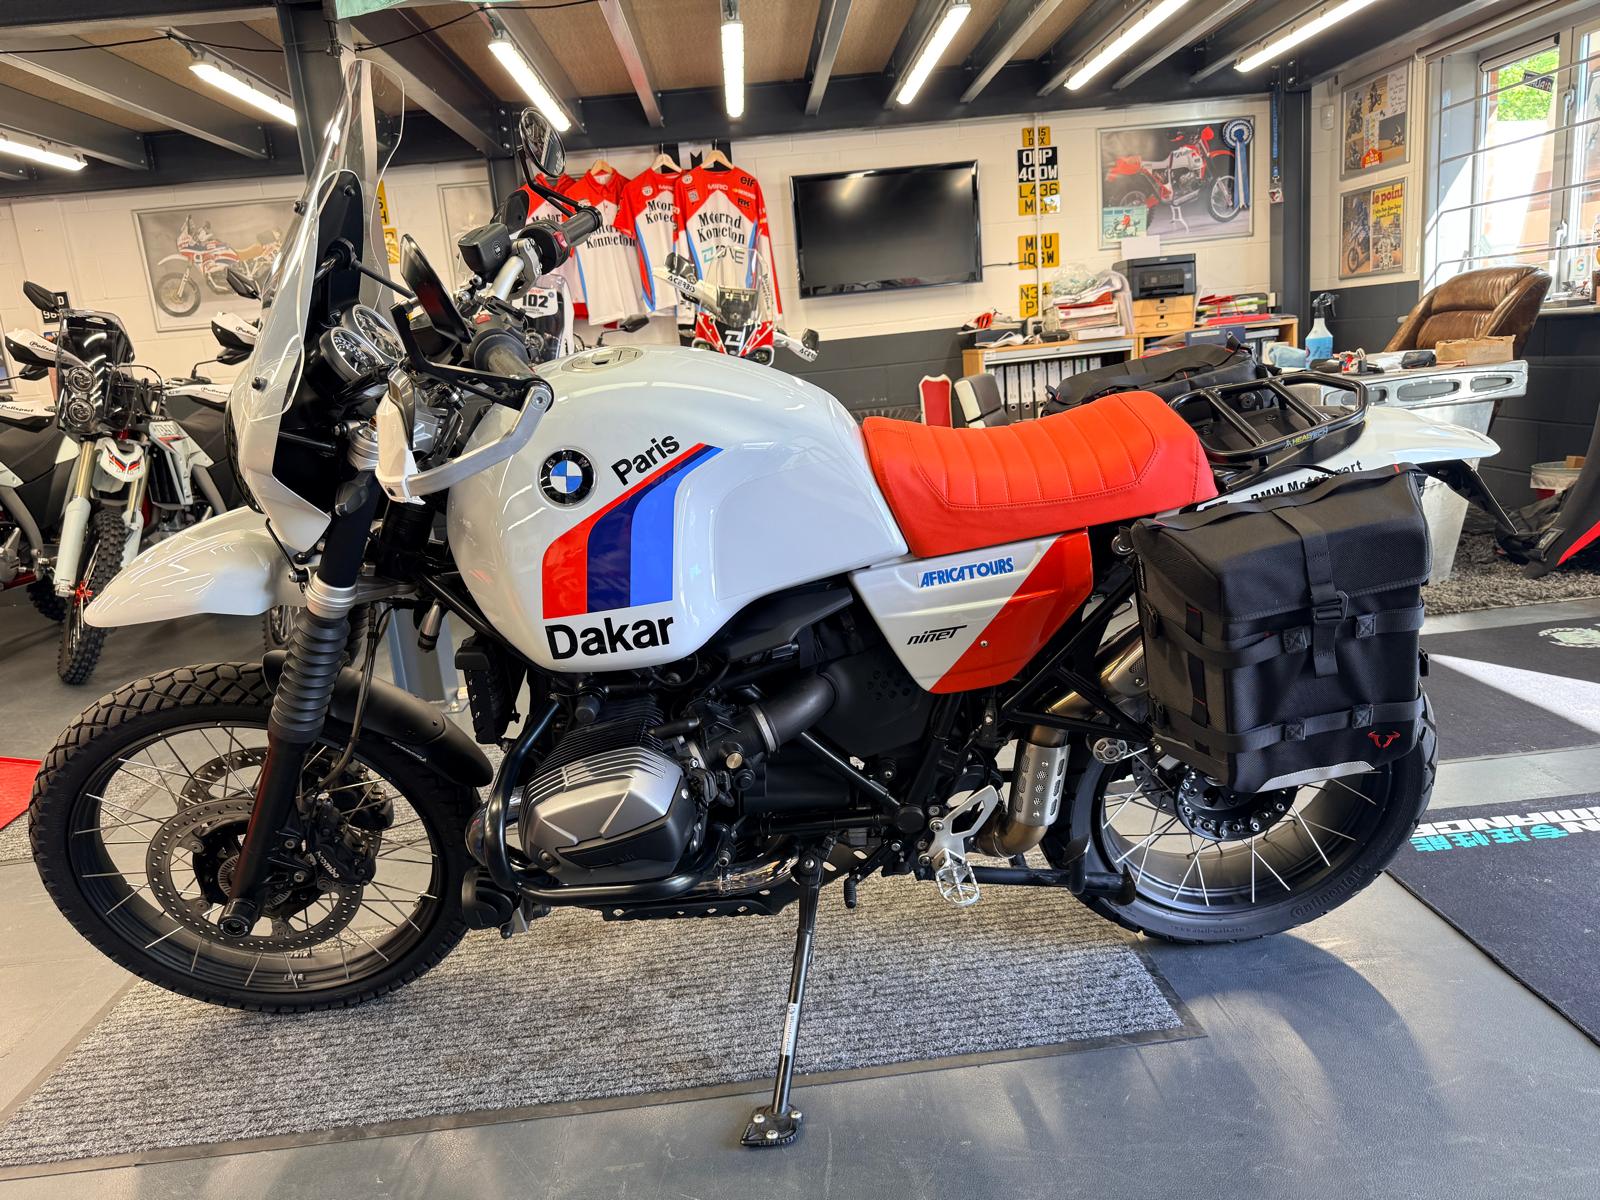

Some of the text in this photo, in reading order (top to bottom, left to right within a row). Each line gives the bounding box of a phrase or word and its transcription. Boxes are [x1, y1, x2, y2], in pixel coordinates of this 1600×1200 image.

[522, 294, 549, 308] 102
[611, 435, 680, 486] Paris
[920, 557, 1014, 588] AFRICATOURS
[544, 616, 674, 660] Dakar
